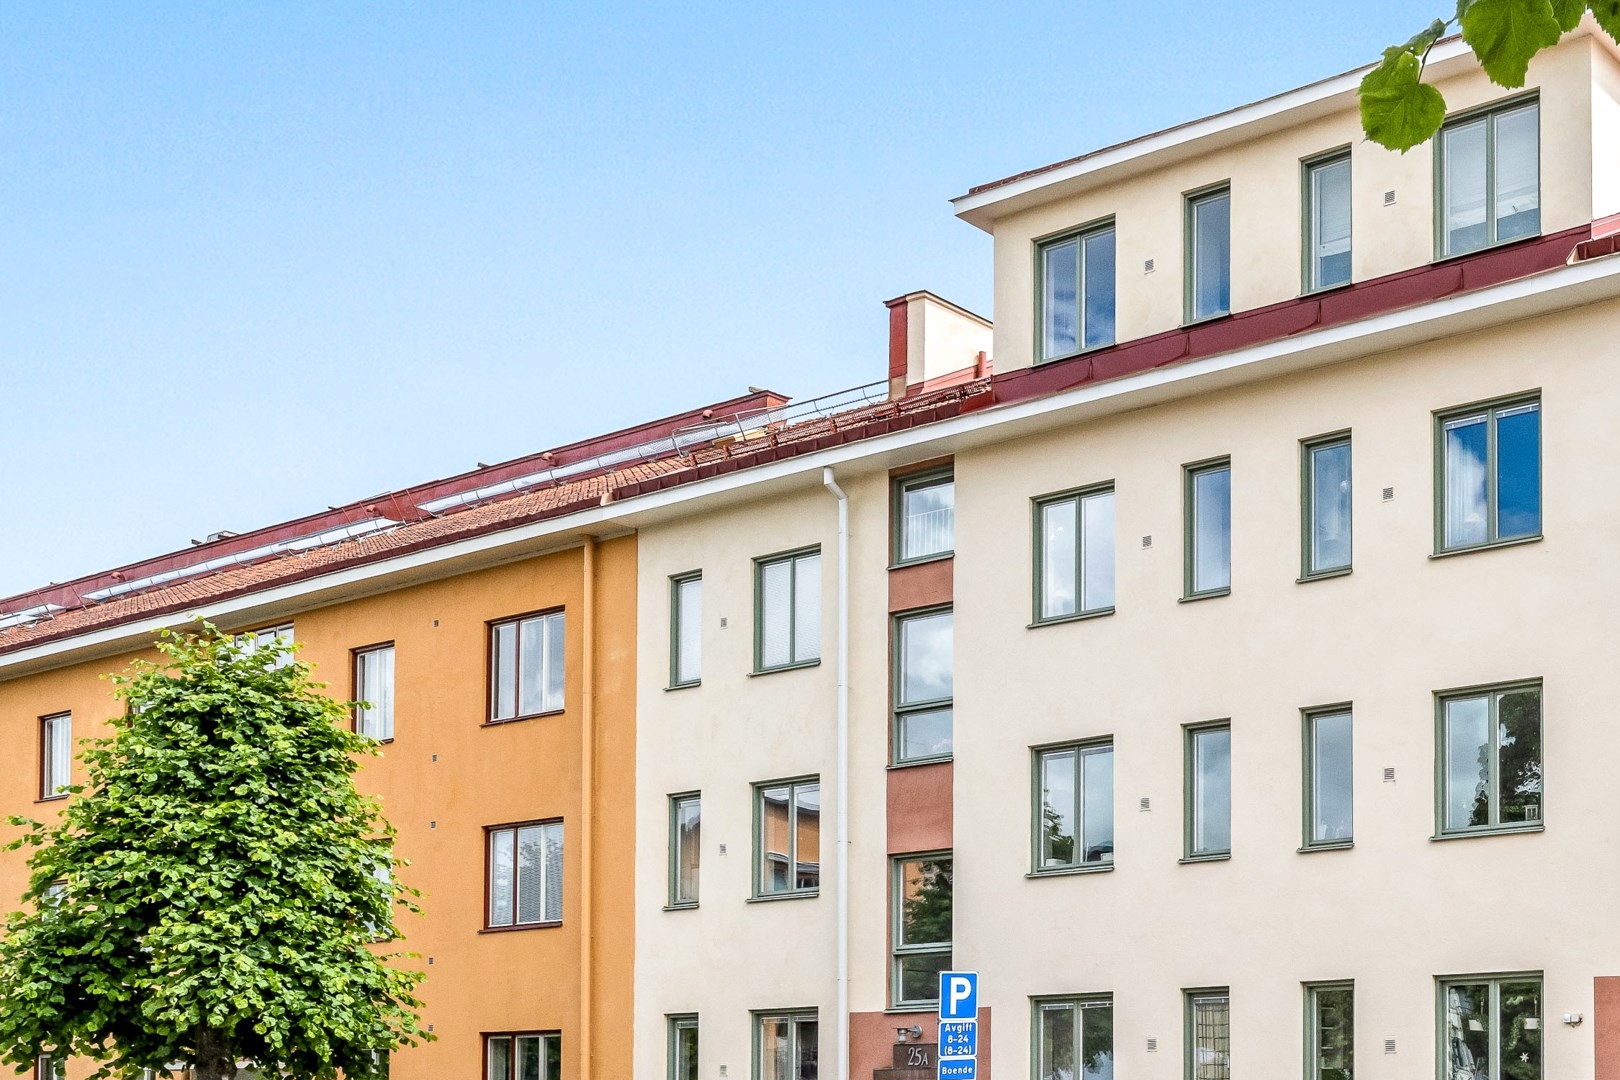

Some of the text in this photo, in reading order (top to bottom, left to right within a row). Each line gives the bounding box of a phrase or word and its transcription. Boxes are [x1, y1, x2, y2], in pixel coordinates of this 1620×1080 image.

[949, 976, 972, 1015] P
[944, 1022, 973, 1034] Avgift
[947, 1034, 969, 1043] 8-24
[944, 1045, 972, 1055] (8-24)
[907, 1046, 929, 1066] 25A
[942, 1065, 973, 1075] Boende
